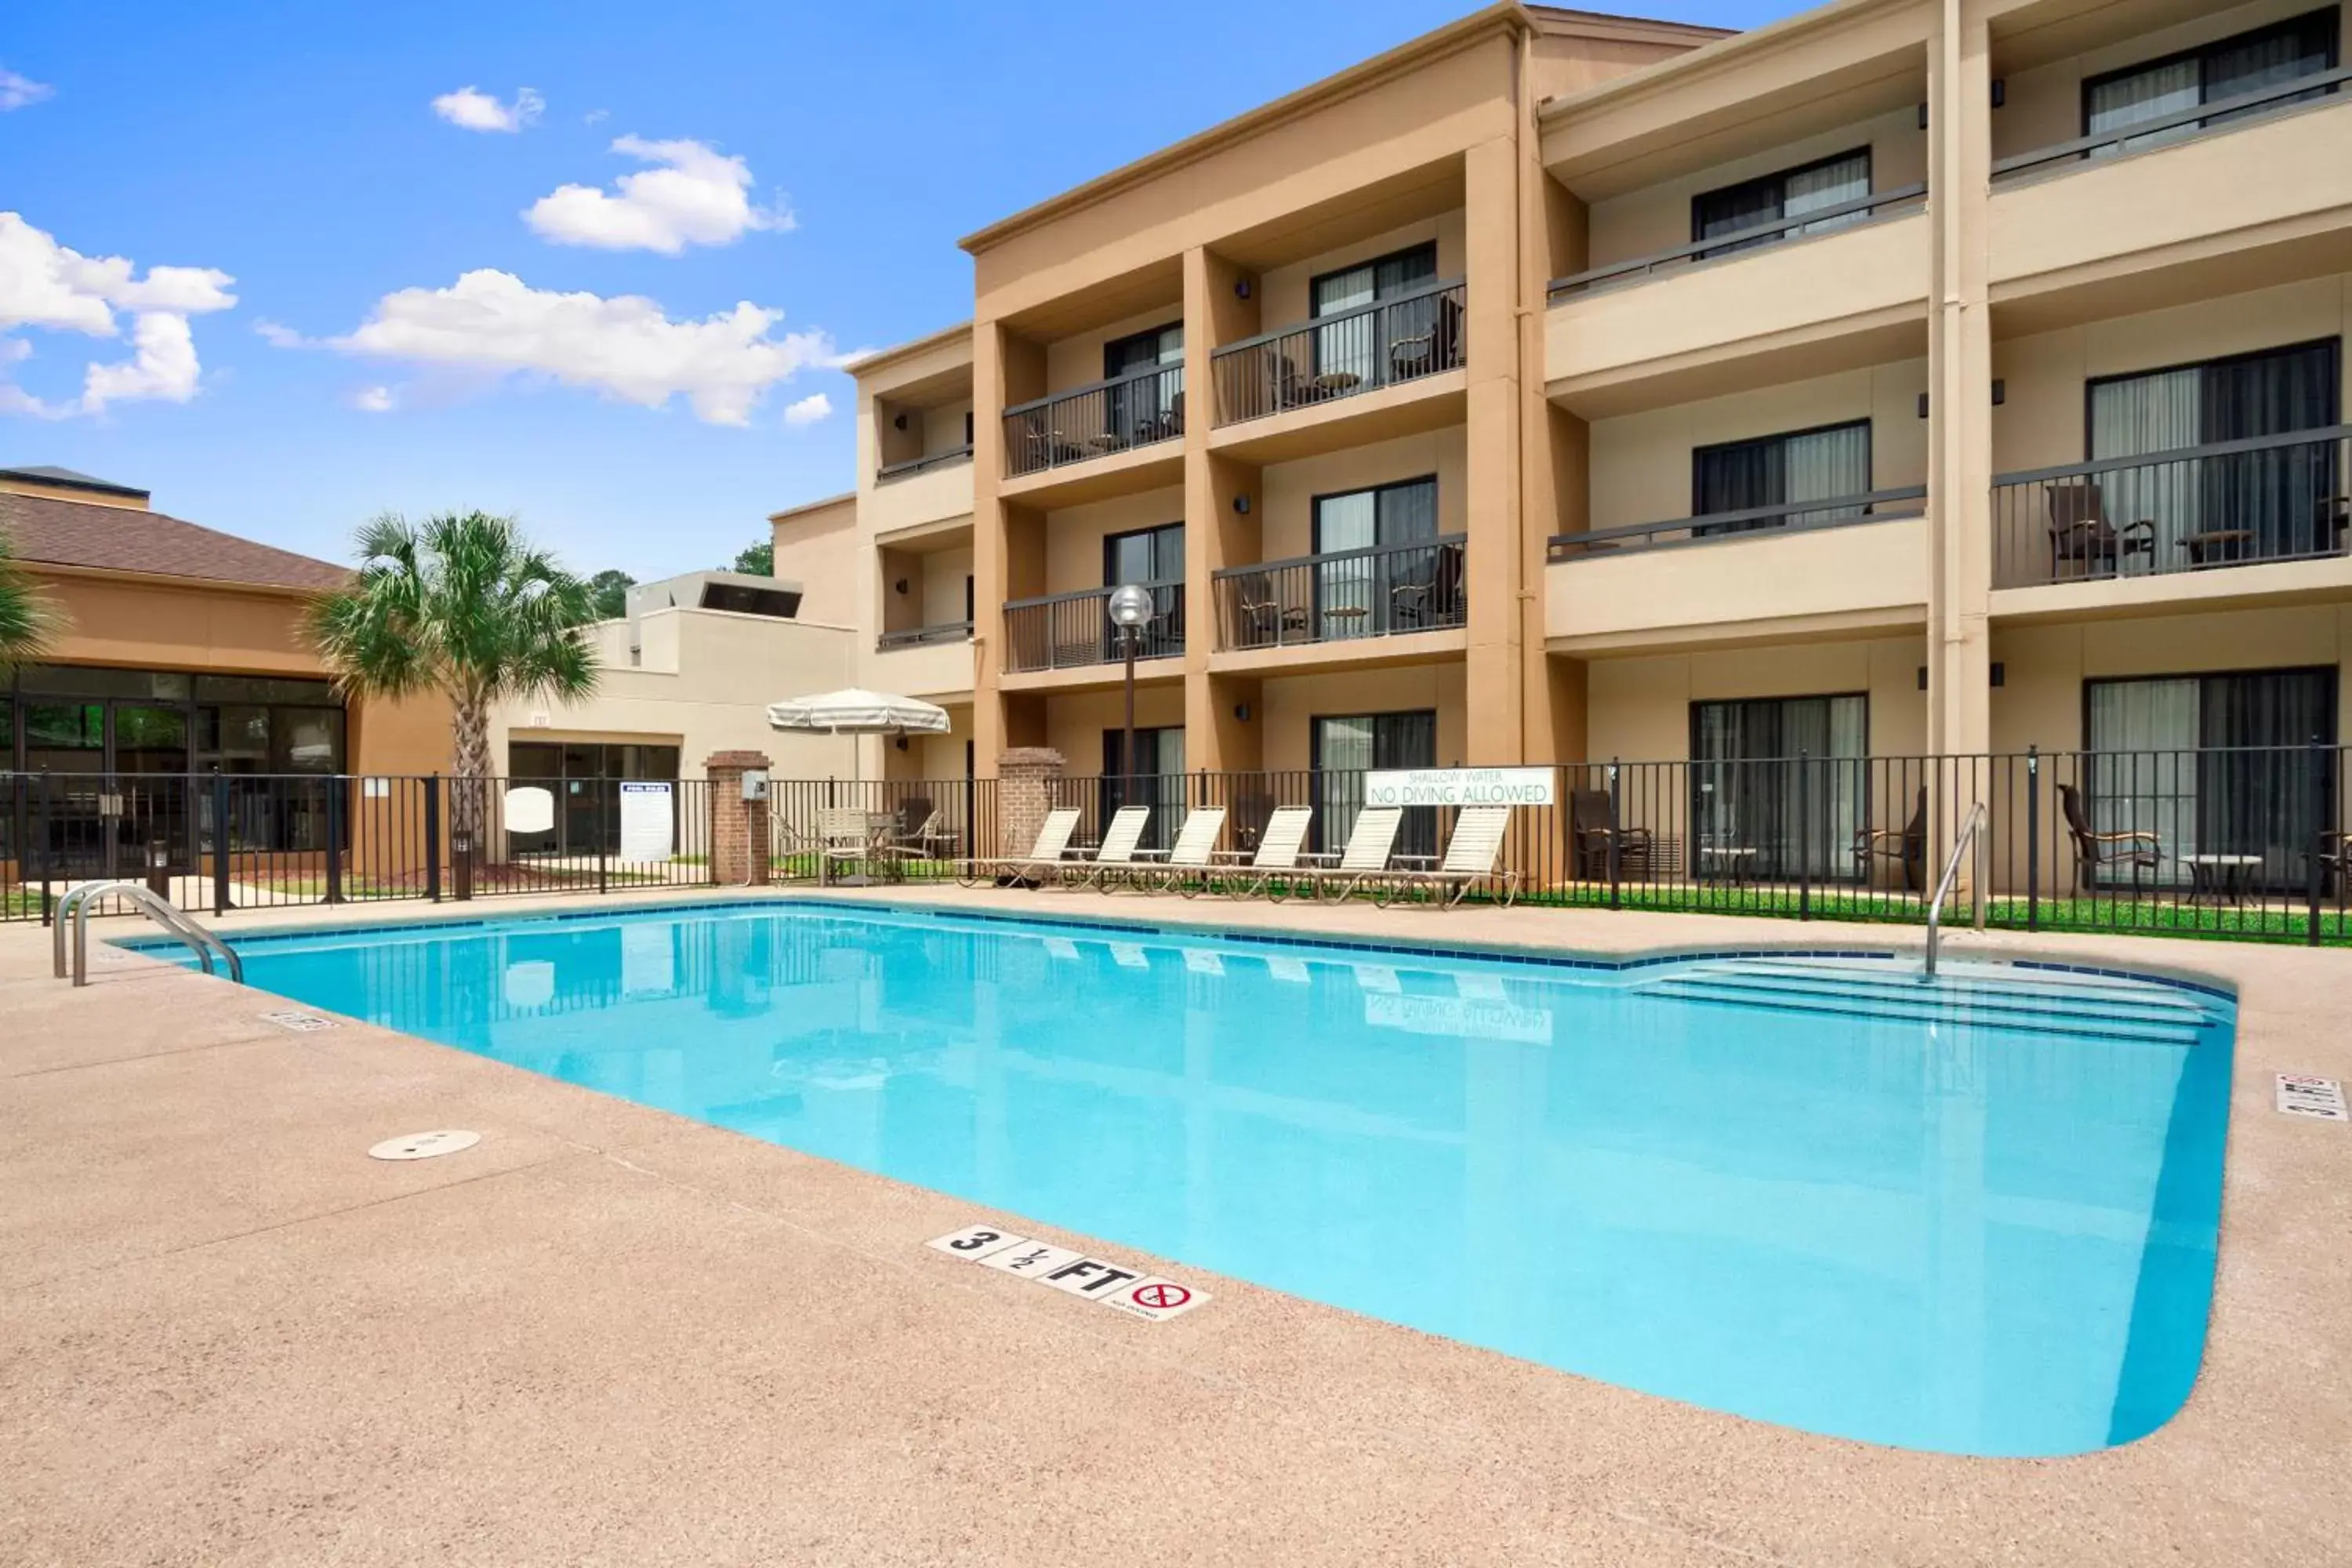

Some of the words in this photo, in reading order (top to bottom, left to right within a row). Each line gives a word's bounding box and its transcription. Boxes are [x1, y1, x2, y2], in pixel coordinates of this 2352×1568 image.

[1408, 771, 1461, 783] SHALLOW
[1465, 771, 1503, 782] WATER
[1371, 787, 1396, 804] NO
[1403, 786, 1455, 803] DIVING
[1462, 785, 1547, 803] ALLOWED
[950, 1232, 1000, 1250] 3
[1047, 1261, 1136, 1292] FT
